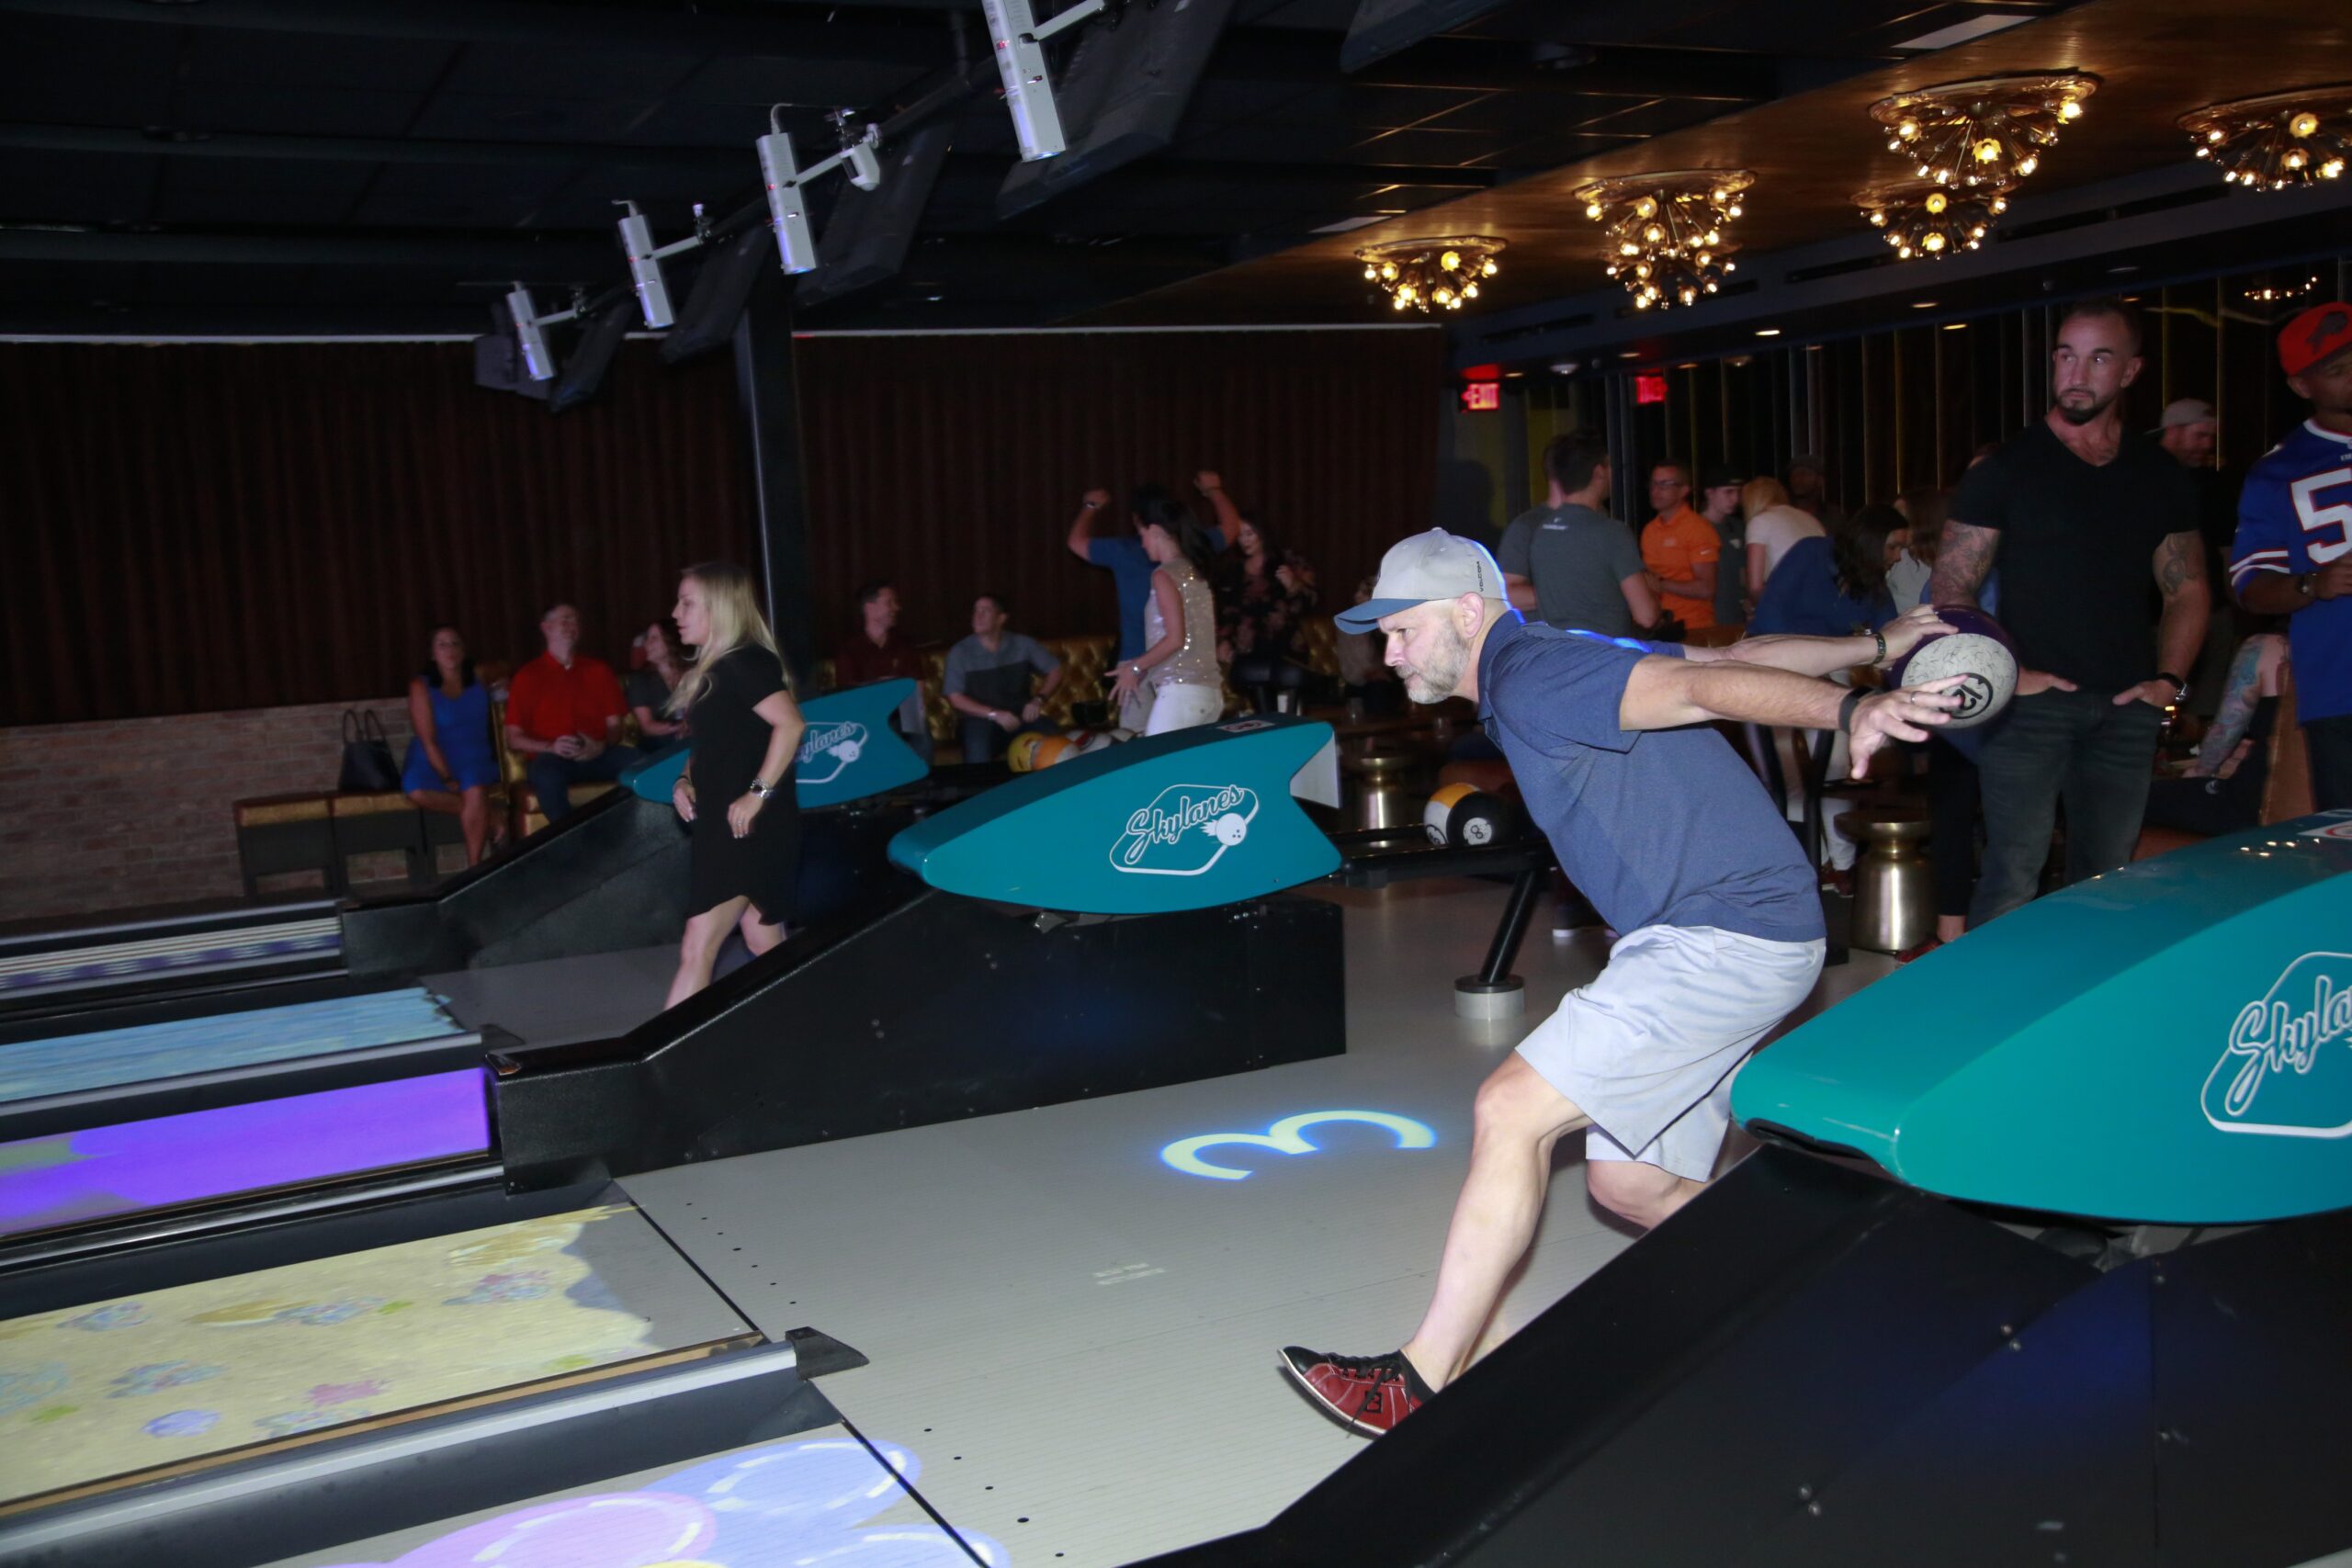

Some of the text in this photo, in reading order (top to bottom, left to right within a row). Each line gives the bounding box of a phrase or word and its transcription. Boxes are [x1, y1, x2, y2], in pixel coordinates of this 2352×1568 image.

[1468, 382, 1498, 410] EXIT
[795, 721, 857, 763] ylanes
[1125, 784, 1245, 864] Skylanes
[1470, 825, 1484, 840] 8
[2224, 975, 2352, 1116] Skyla
